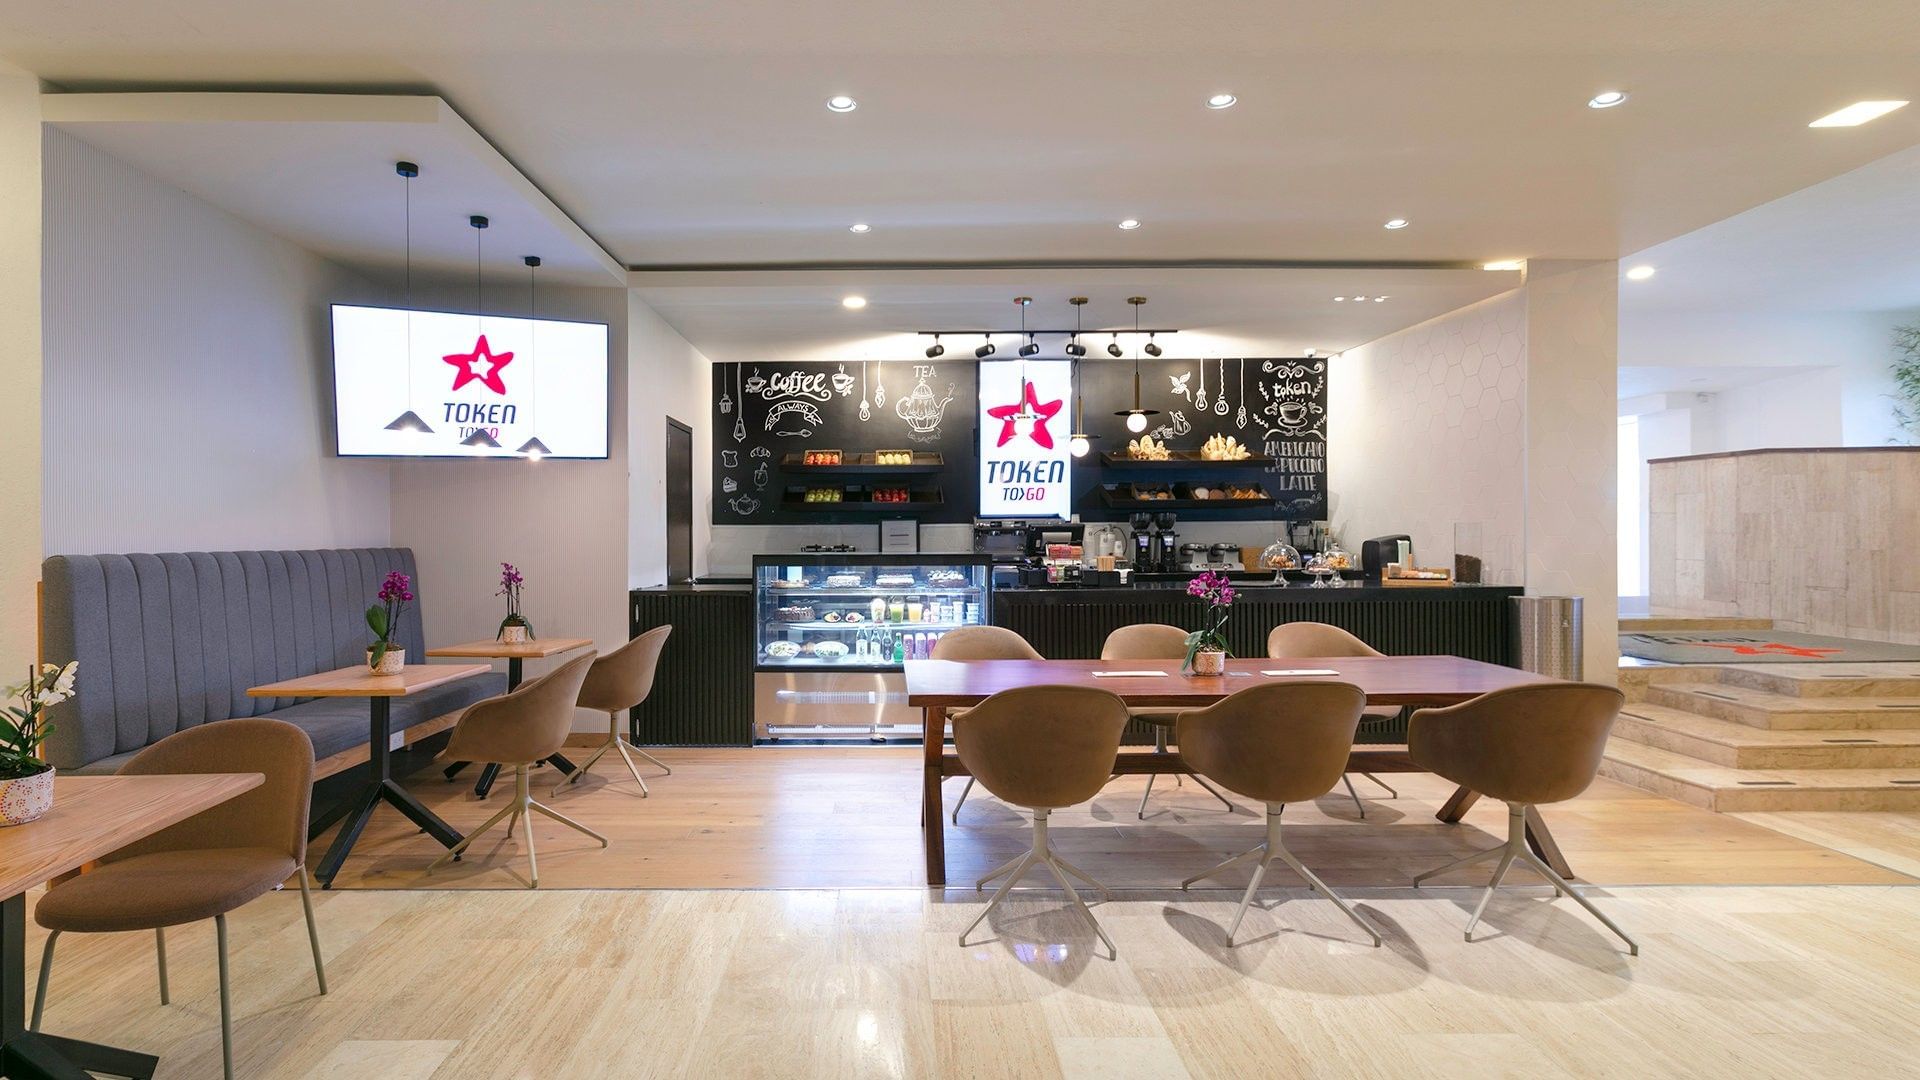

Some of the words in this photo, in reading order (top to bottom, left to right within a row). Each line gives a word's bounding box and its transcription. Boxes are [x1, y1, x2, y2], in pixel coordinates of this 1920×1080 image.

[913, 366, 937, 377] TEA
[770, 371, 826, 393] Coffee
[1272, 378, 1312, 397] token
[443, 403, 516, 424] TOKEN
[778, 403, 809, 412] ALWAYS
[1264, 441, 1325, 457] AMERICANO
[987, 460, 1065, 483] TOKEN
[1280, 475, 1317, 491] LATTE
